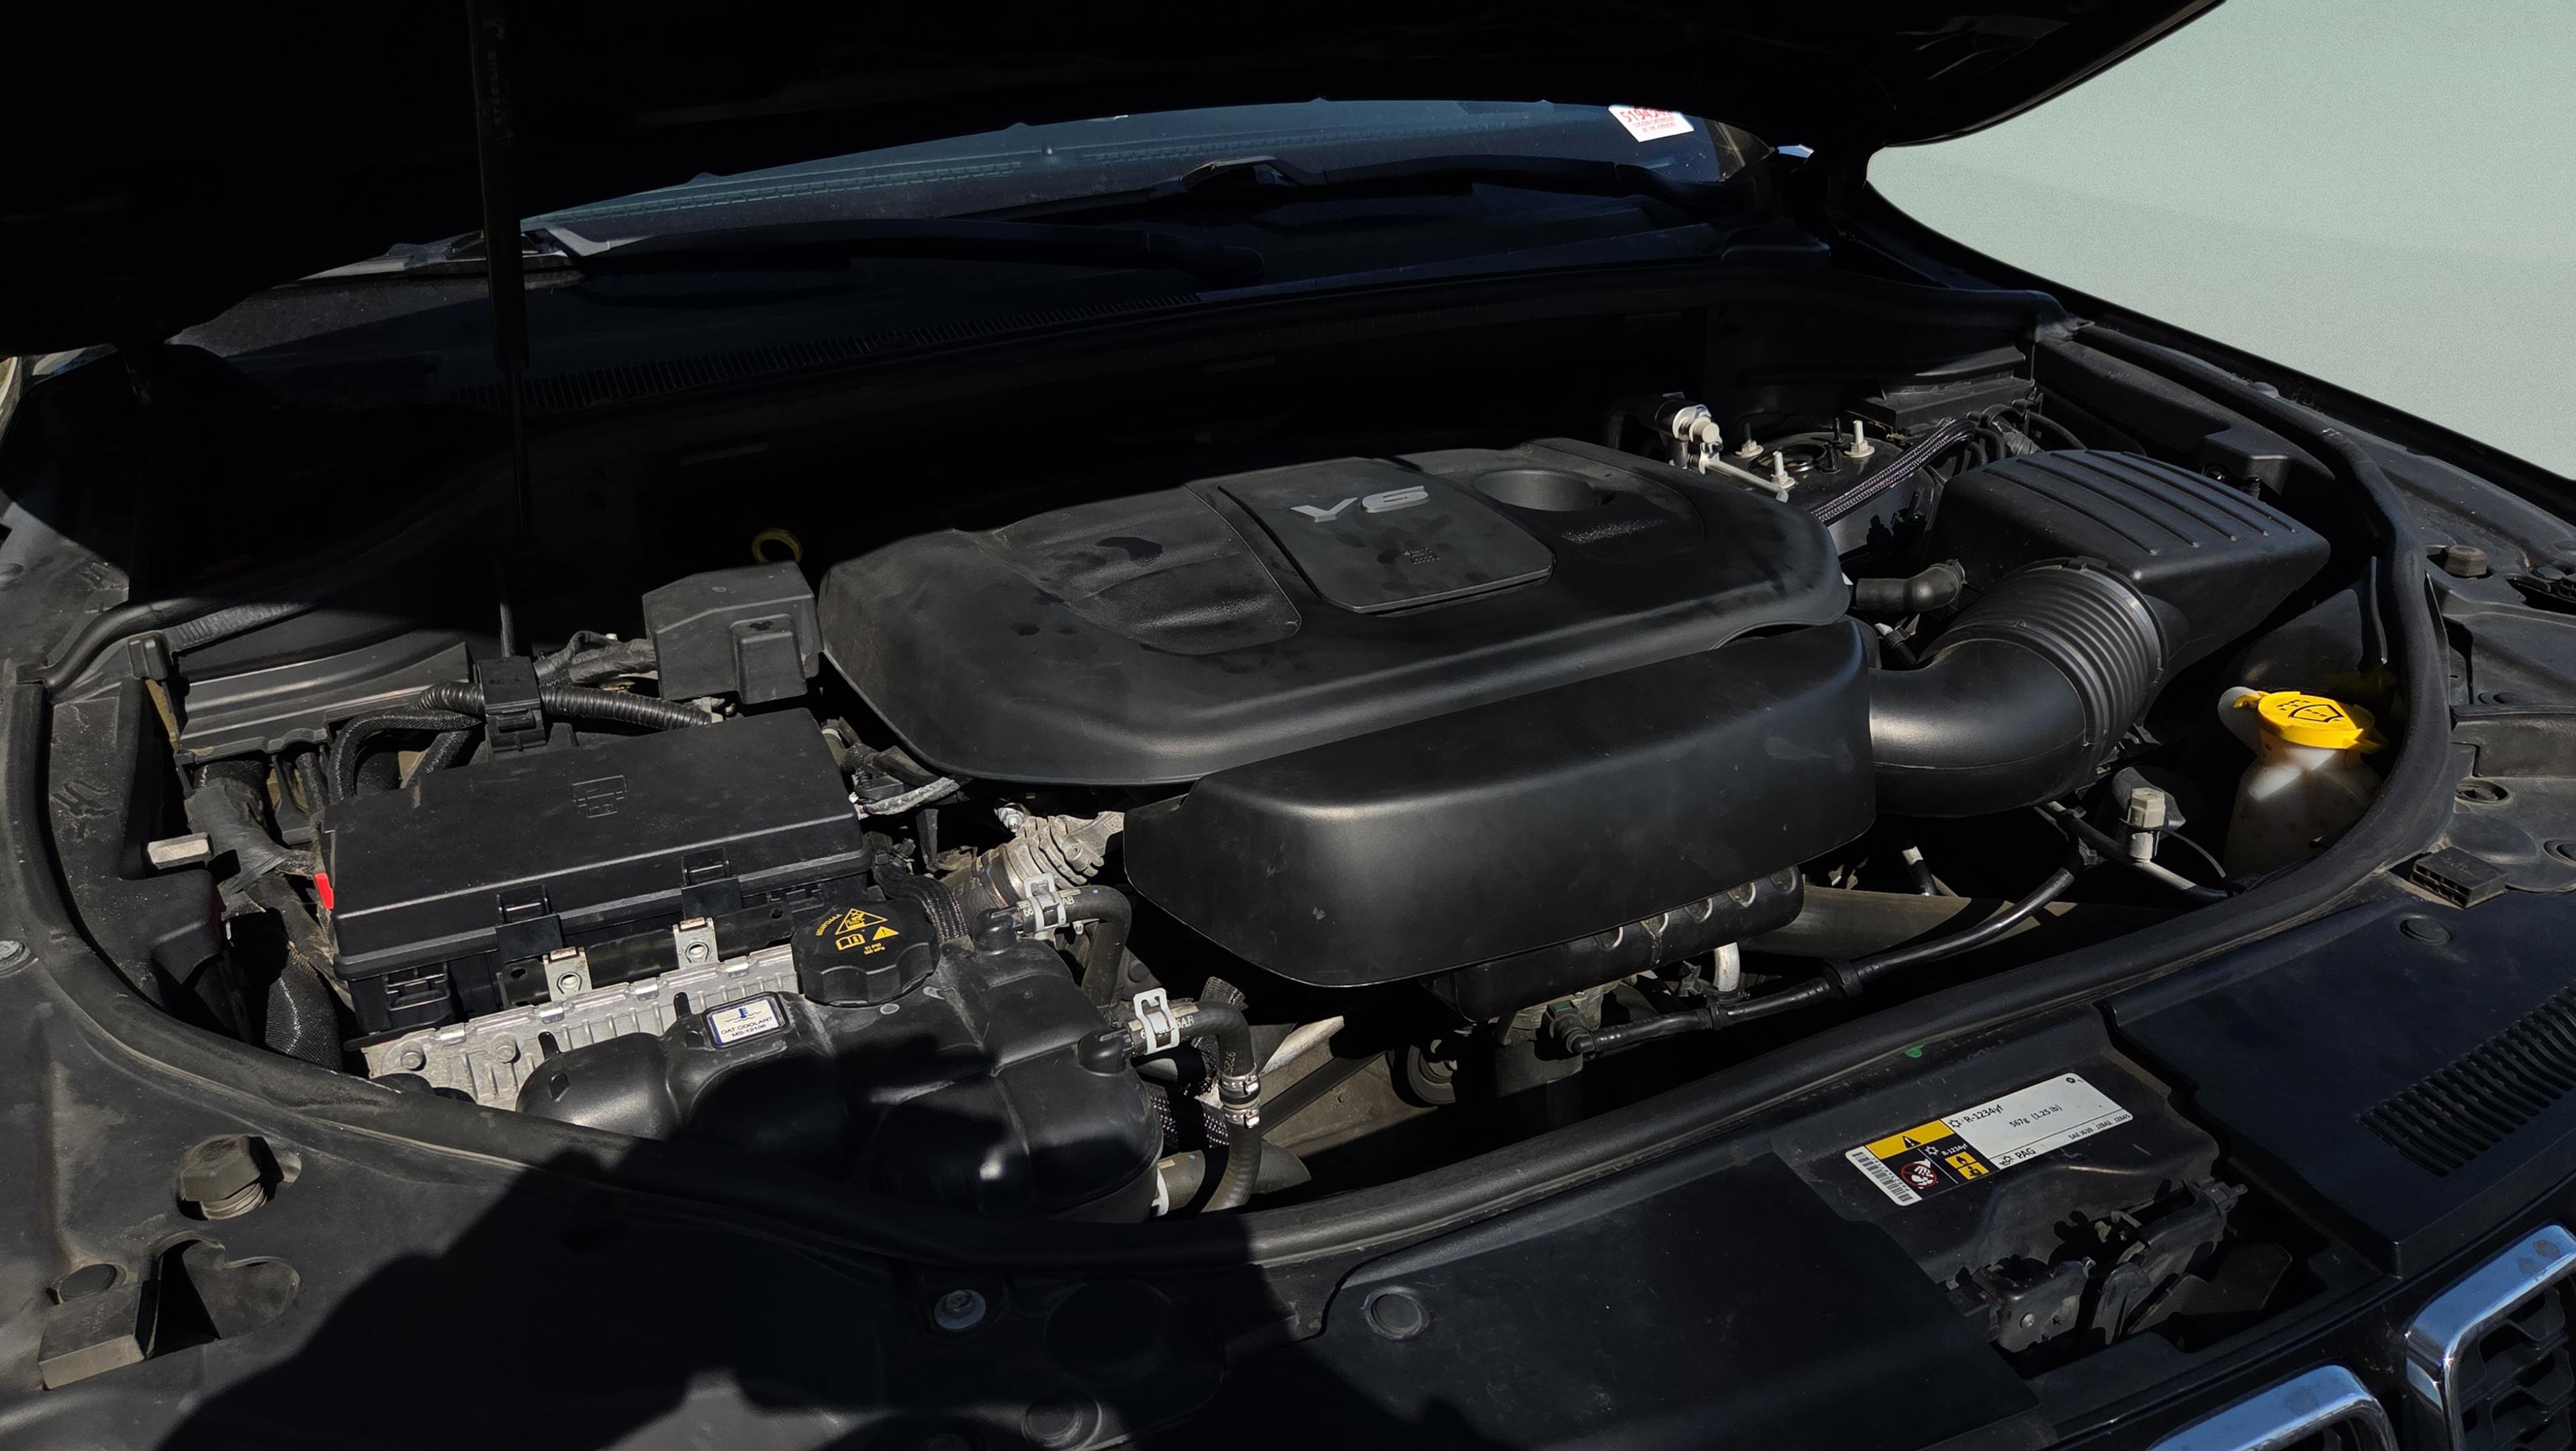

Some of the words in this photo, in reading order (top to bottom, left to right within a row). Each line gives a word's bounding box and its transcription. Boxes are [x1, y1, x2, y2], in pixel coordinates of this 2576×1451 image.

[1289, 485, 1430, 523] V6
[721, 1027, 736, 1035] OAT
[737, 1016, 773, 1030] COOLANT
[1963, 1104, 2004, 1123] R-1234yf
[2009, 1118, 2030, 1128] 567g
[2031, 1109, 2052, 1120] (1.25
[2051, 1104, 2063, 1112] lb)
[2015, 1147, 2036, 1159] PAG
